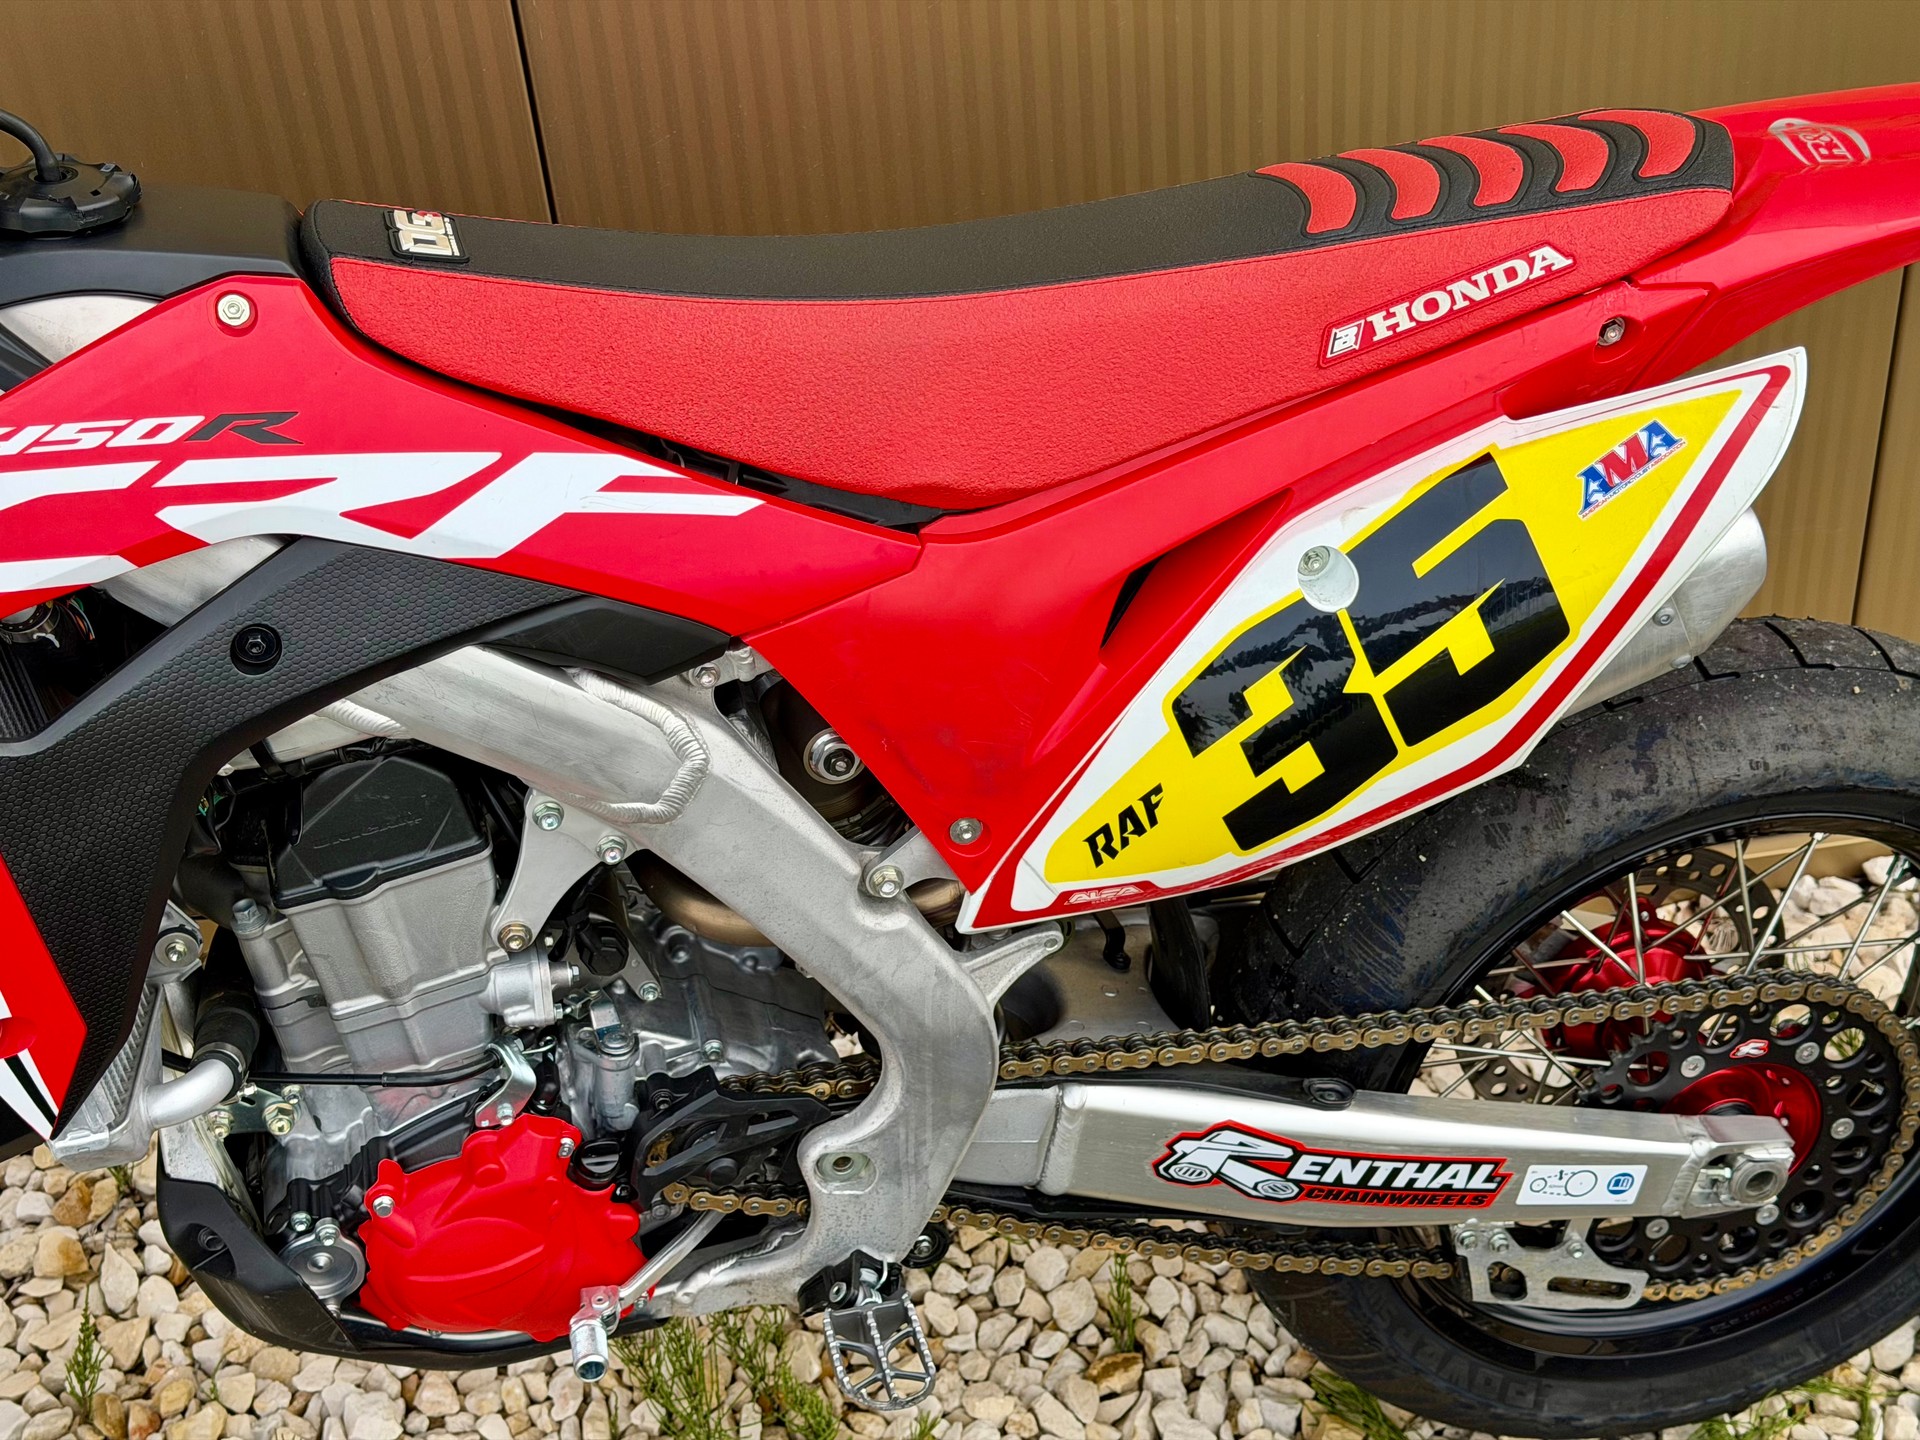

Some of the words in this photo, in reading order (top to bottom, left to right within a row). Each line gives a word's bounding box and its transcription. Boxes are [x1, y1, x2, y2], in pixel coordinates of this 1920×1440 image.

[1366, 245, 1574, 342] HONDA
[1577, 420, 1683, 515] AMA
[1582, 495, 1611, 519] AMERICAN
[1171, 452, 1571, 851] 35
[1082, 782, 1164, 868] RAF
[1064, 885, 1144, 905] ALFA
[1303, 1185, 1489, 1207] CHAINWHEELS
